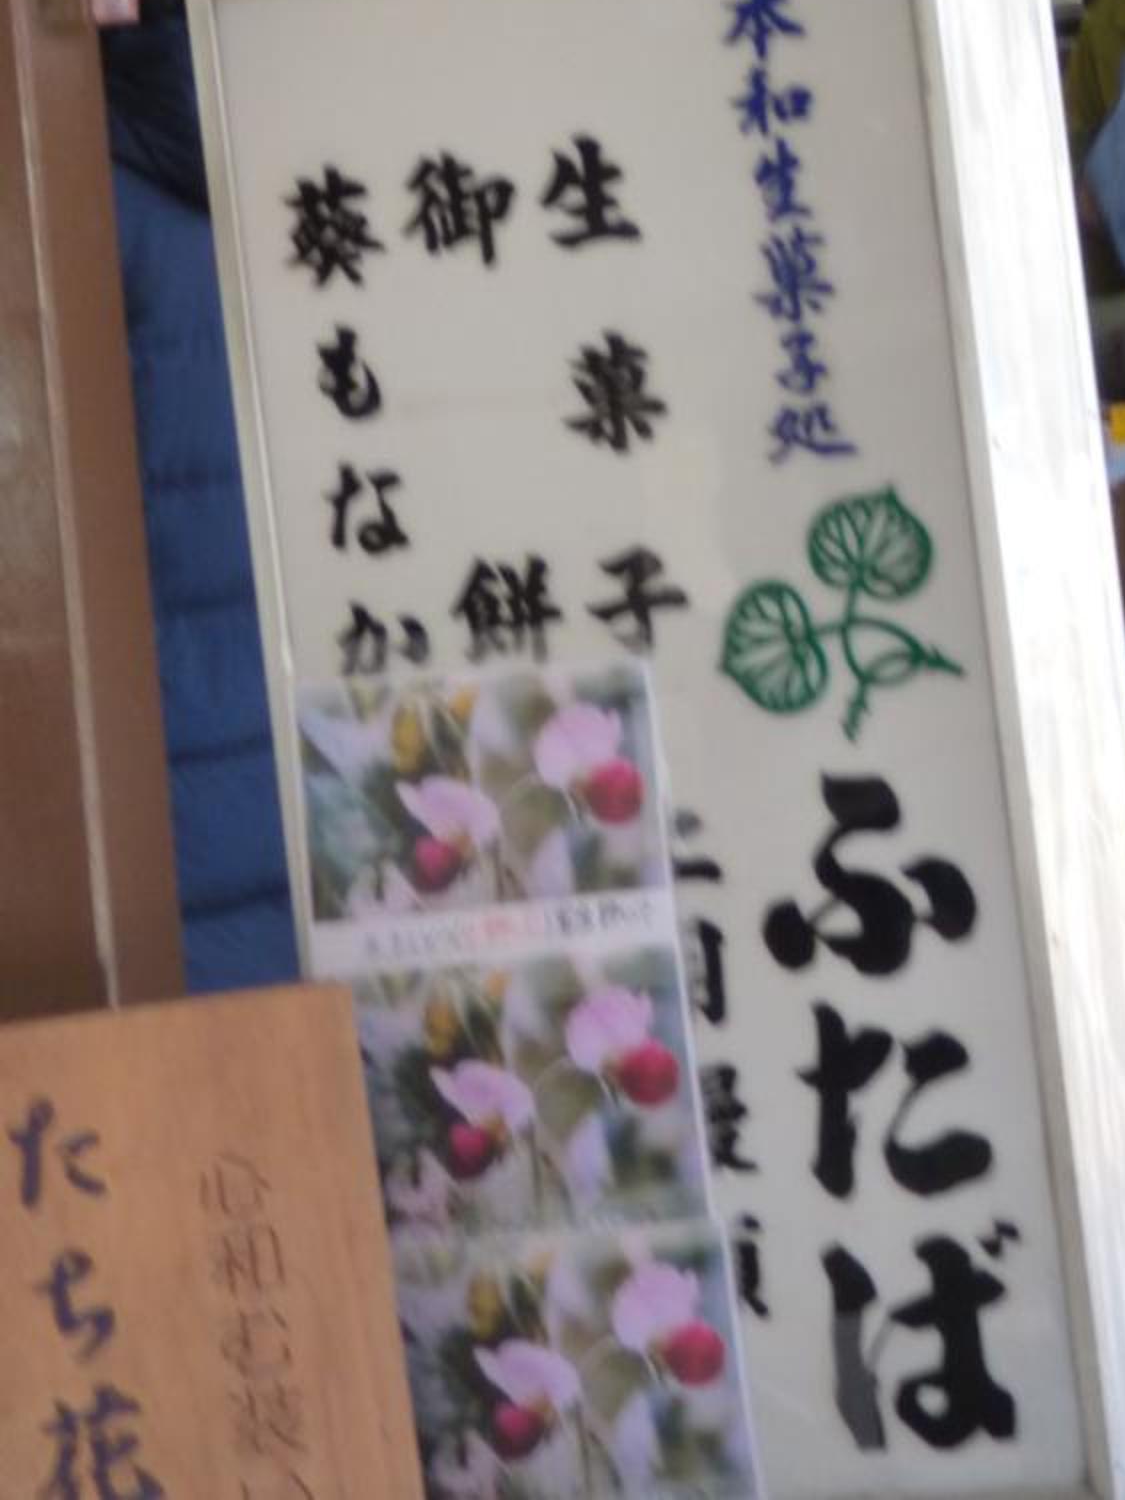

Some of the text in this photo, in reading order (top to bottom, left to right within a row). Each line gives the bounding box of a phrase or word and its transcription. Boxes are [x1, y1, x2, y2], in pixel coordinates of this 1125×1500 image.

[286, 165, 430, 677] 葵もなか
[541, 134, 690, 653] 生菓子
[764, 769, 1023, 1454] ふたば
